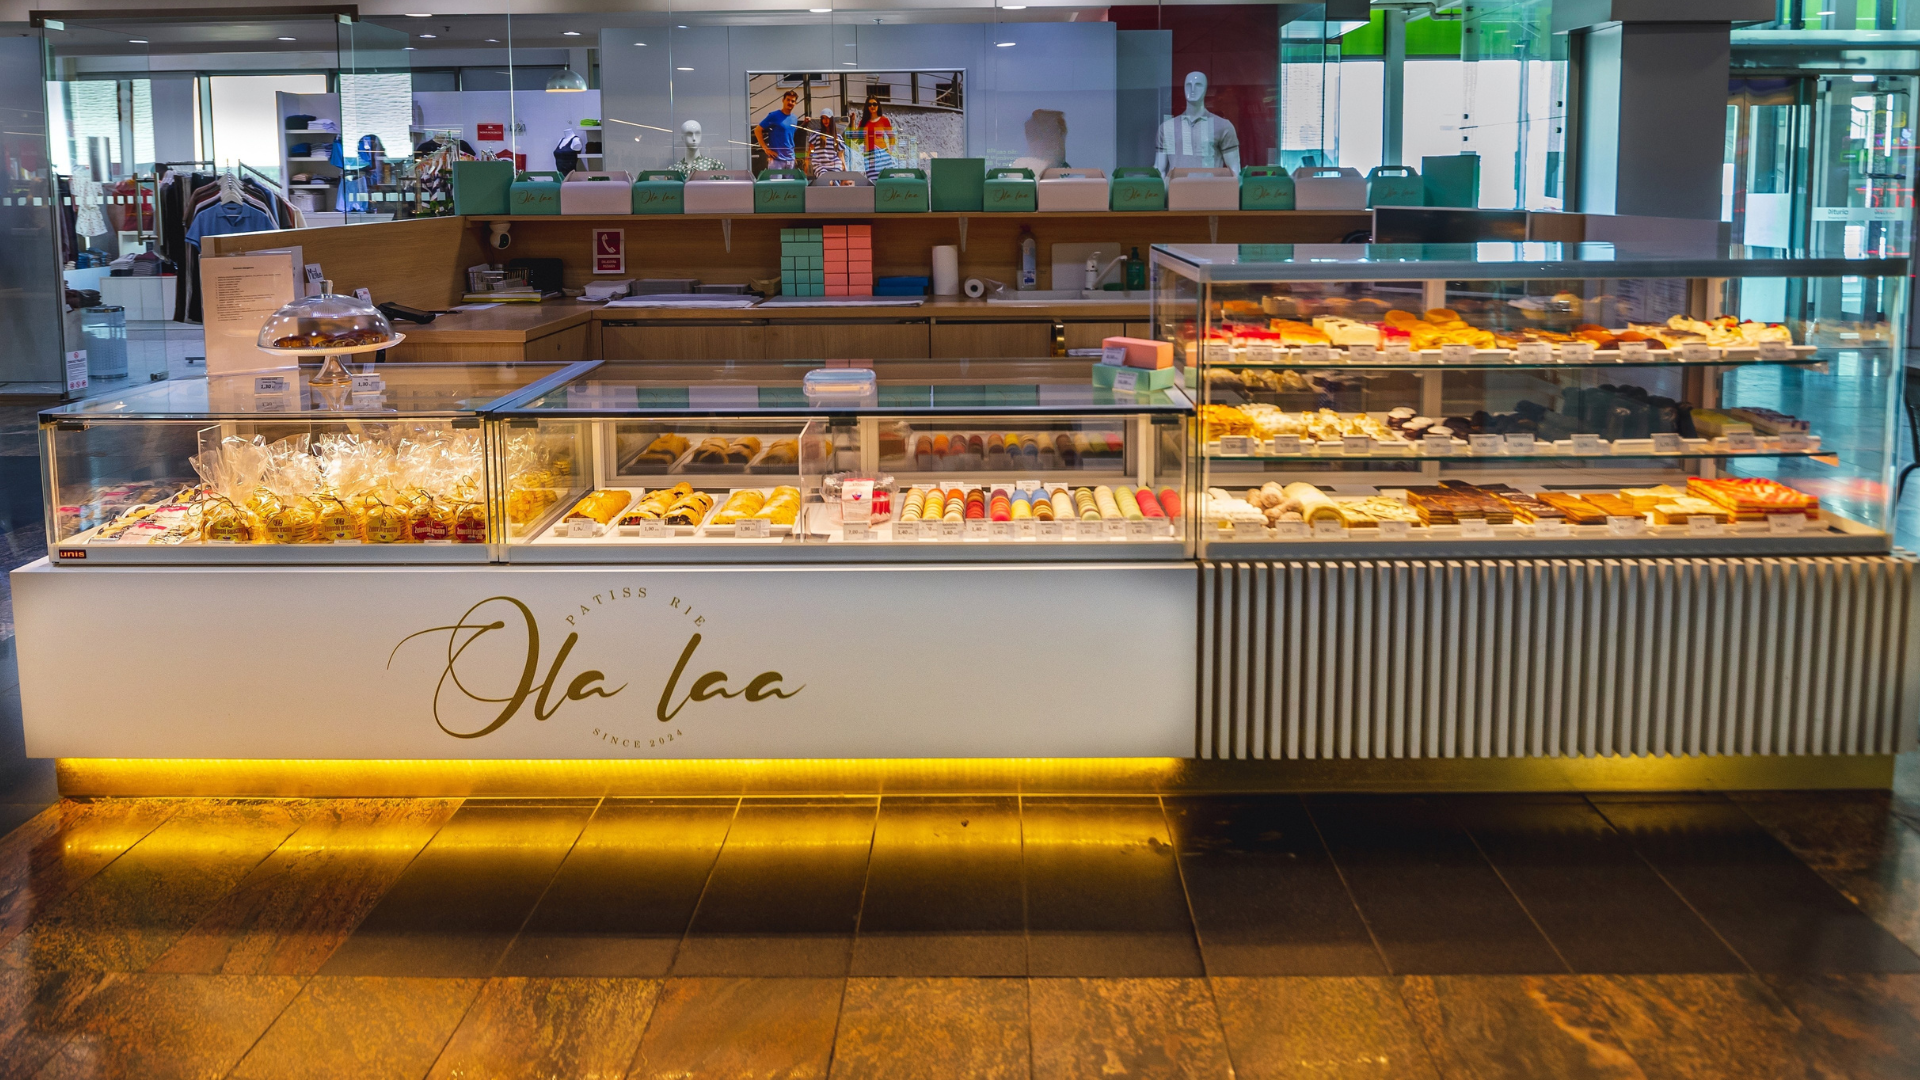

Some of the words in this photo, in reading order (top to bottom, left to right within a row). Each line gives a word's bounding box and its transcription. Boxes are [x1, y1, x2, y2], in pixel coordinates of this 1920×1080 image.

[566, 587, 647, 627] PATISS
[669, 596, 706, 628] RIE
[387, 596, 628, 739] Ola
[656, 632, 807, 723] laa
[592, 727, 641, 749] SINCE
[649, 729, 683, 749] 2024
